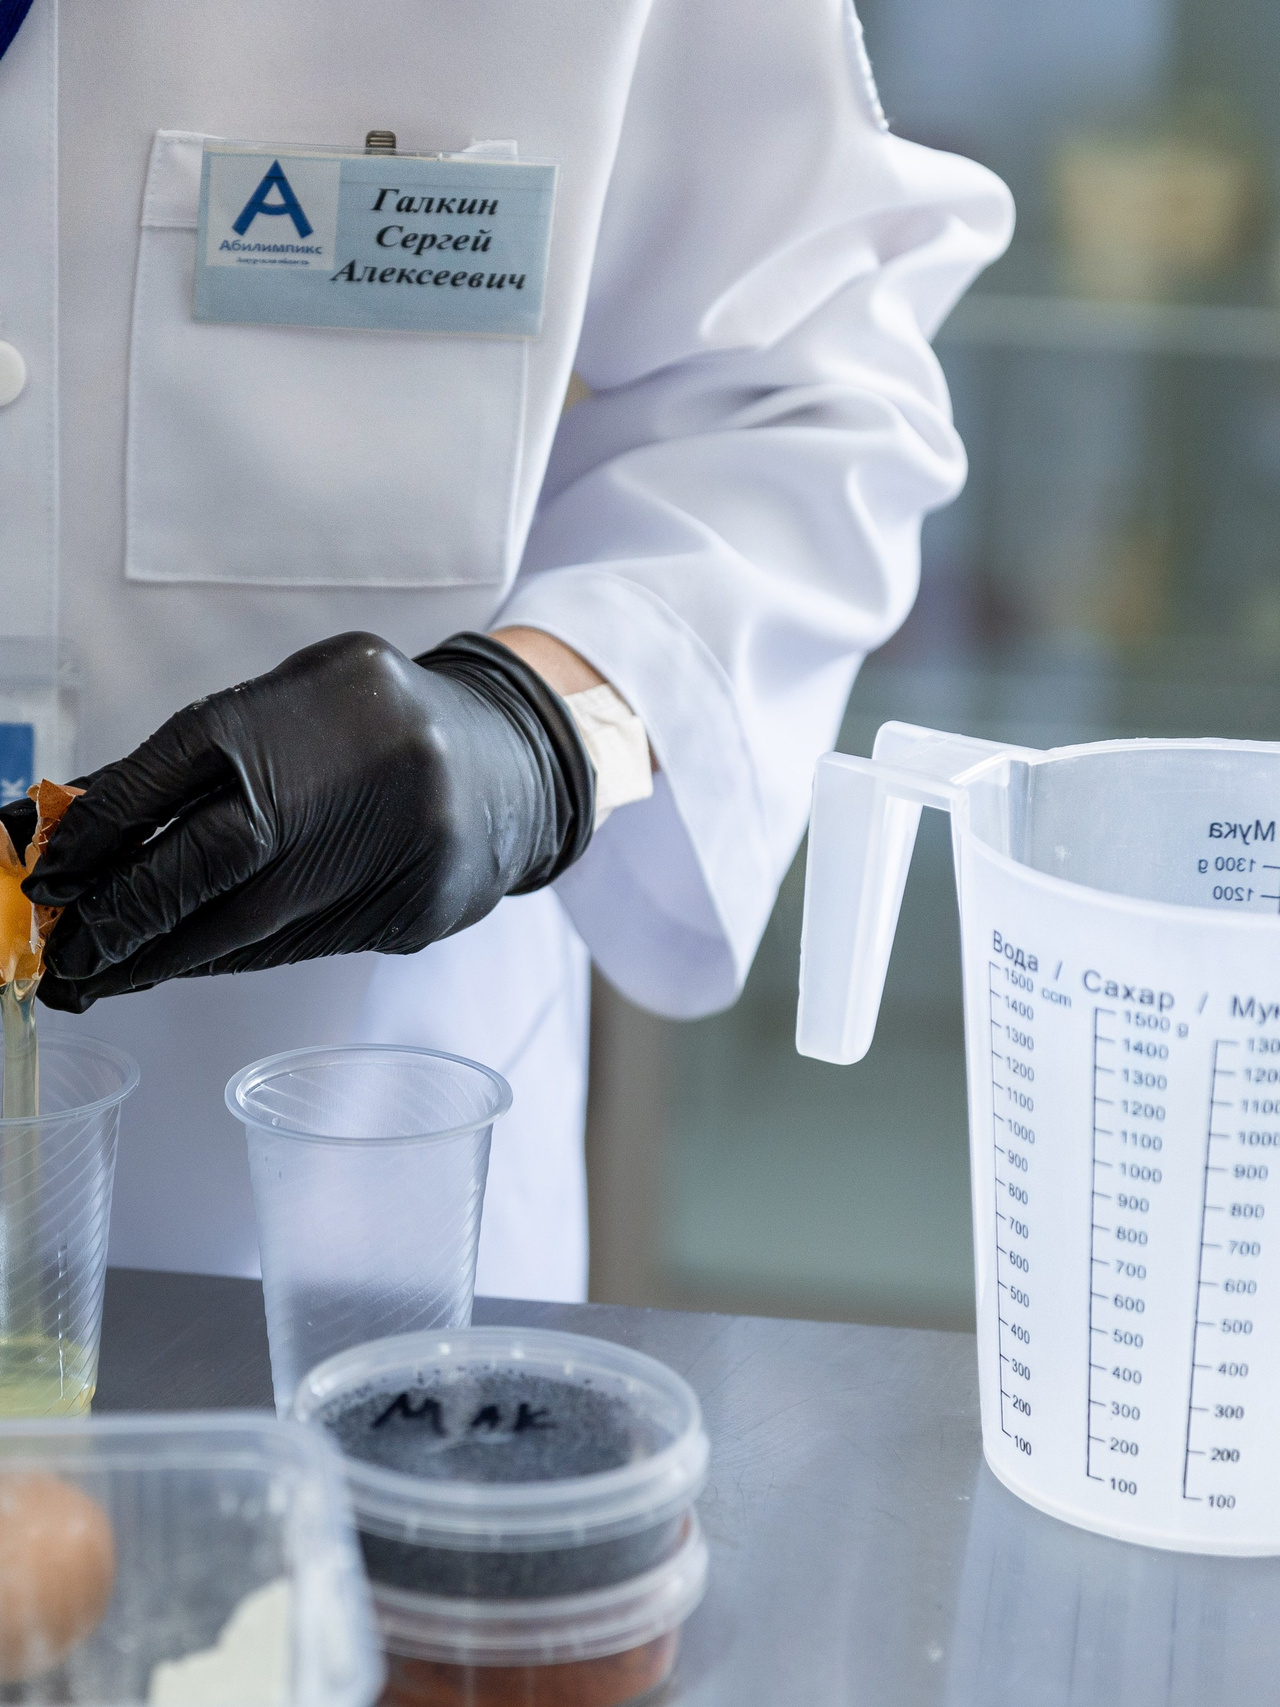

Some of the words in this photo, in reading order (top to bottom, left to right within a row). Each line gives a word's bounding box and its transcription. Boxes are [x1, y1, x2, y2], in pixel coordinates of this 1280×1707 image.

[370, 187, 499, 216] Галкин
[219, 239, 323, 255] Абилимпикс
[376, 224, 492, 255] Сергей
[330, 259, 526, 290] Алексеевич
[992, 929, 1038, 973] Вода
[1082, 969, 1176, 1013] Сахар
[1004, 967, 1034, 993] 1500
[1042, 986, 1072, 1008] ccm
[1004, 995, 1034, 1022] 1400
[1124, 1009, 1169, 1032] 1500
[1005, 1024, 1035, 1051] 1300
[1124, 1038, 1169, 1060] 1400
[1006, 1055, 1035, 1082] 1200
[1244, 1068, 1280, 1082] 120
[1122, 1069, 1168, 1091] 1300
[1007, 1084, 1034, 1112] 1100
[1122, 1099, 1166, 1122] 1200
[1007, 1119, 1036, 1145] 1000
[1120, 1129, 1163, 1151] 1100
[1008, 1149, 1028, 1172] 900
[1120, 1162, 1163, 1183] 1000
[1233, 1164, 1269, 1180] 900
[1009, 1182, 1029, 1204] 800
[1117, 1193, 1150, 1212] 900
[1231, 1202, 1265, 1219] 800
[1009, 1216, 1029, 1239] 700
[1116, 1226, 1148, 1246] 800
[1228, 1240, 1262, 1257] 700
[1010, 1251, 1029, 1273] 600
[1115, 1260, 1147, 1280] 700
[1011, 1285, 1030, 1308] 500
[1225, 1278, 1258, 1296] 600
[1114, 1294, 1146, 1314] 600
[1011, 1323, 1030, 1344] 400
[1221, 1319, 1254, 1336] 500
[1113, 1329, 1144, 1349] 500
[1012, 1358, 1031, 1380] 300
[1112, 1365, 1143, 1385] 400
[1218, 1362, 1249, 1378] 400
[1012, 1394, 1032, 1417] 200
[1111, 1402, 1141, 1421] 300
[1215, 1404, 1245, 1420] 300
[1014, 1436, 1032, 1456] 100
[1110, 1438, 1140, 1456] 200
[1211, 1448, 1240, 1463] 200
[1110, 1477, 1138, 1496] 100
[1208, 1494, 1236, 1510] 100
